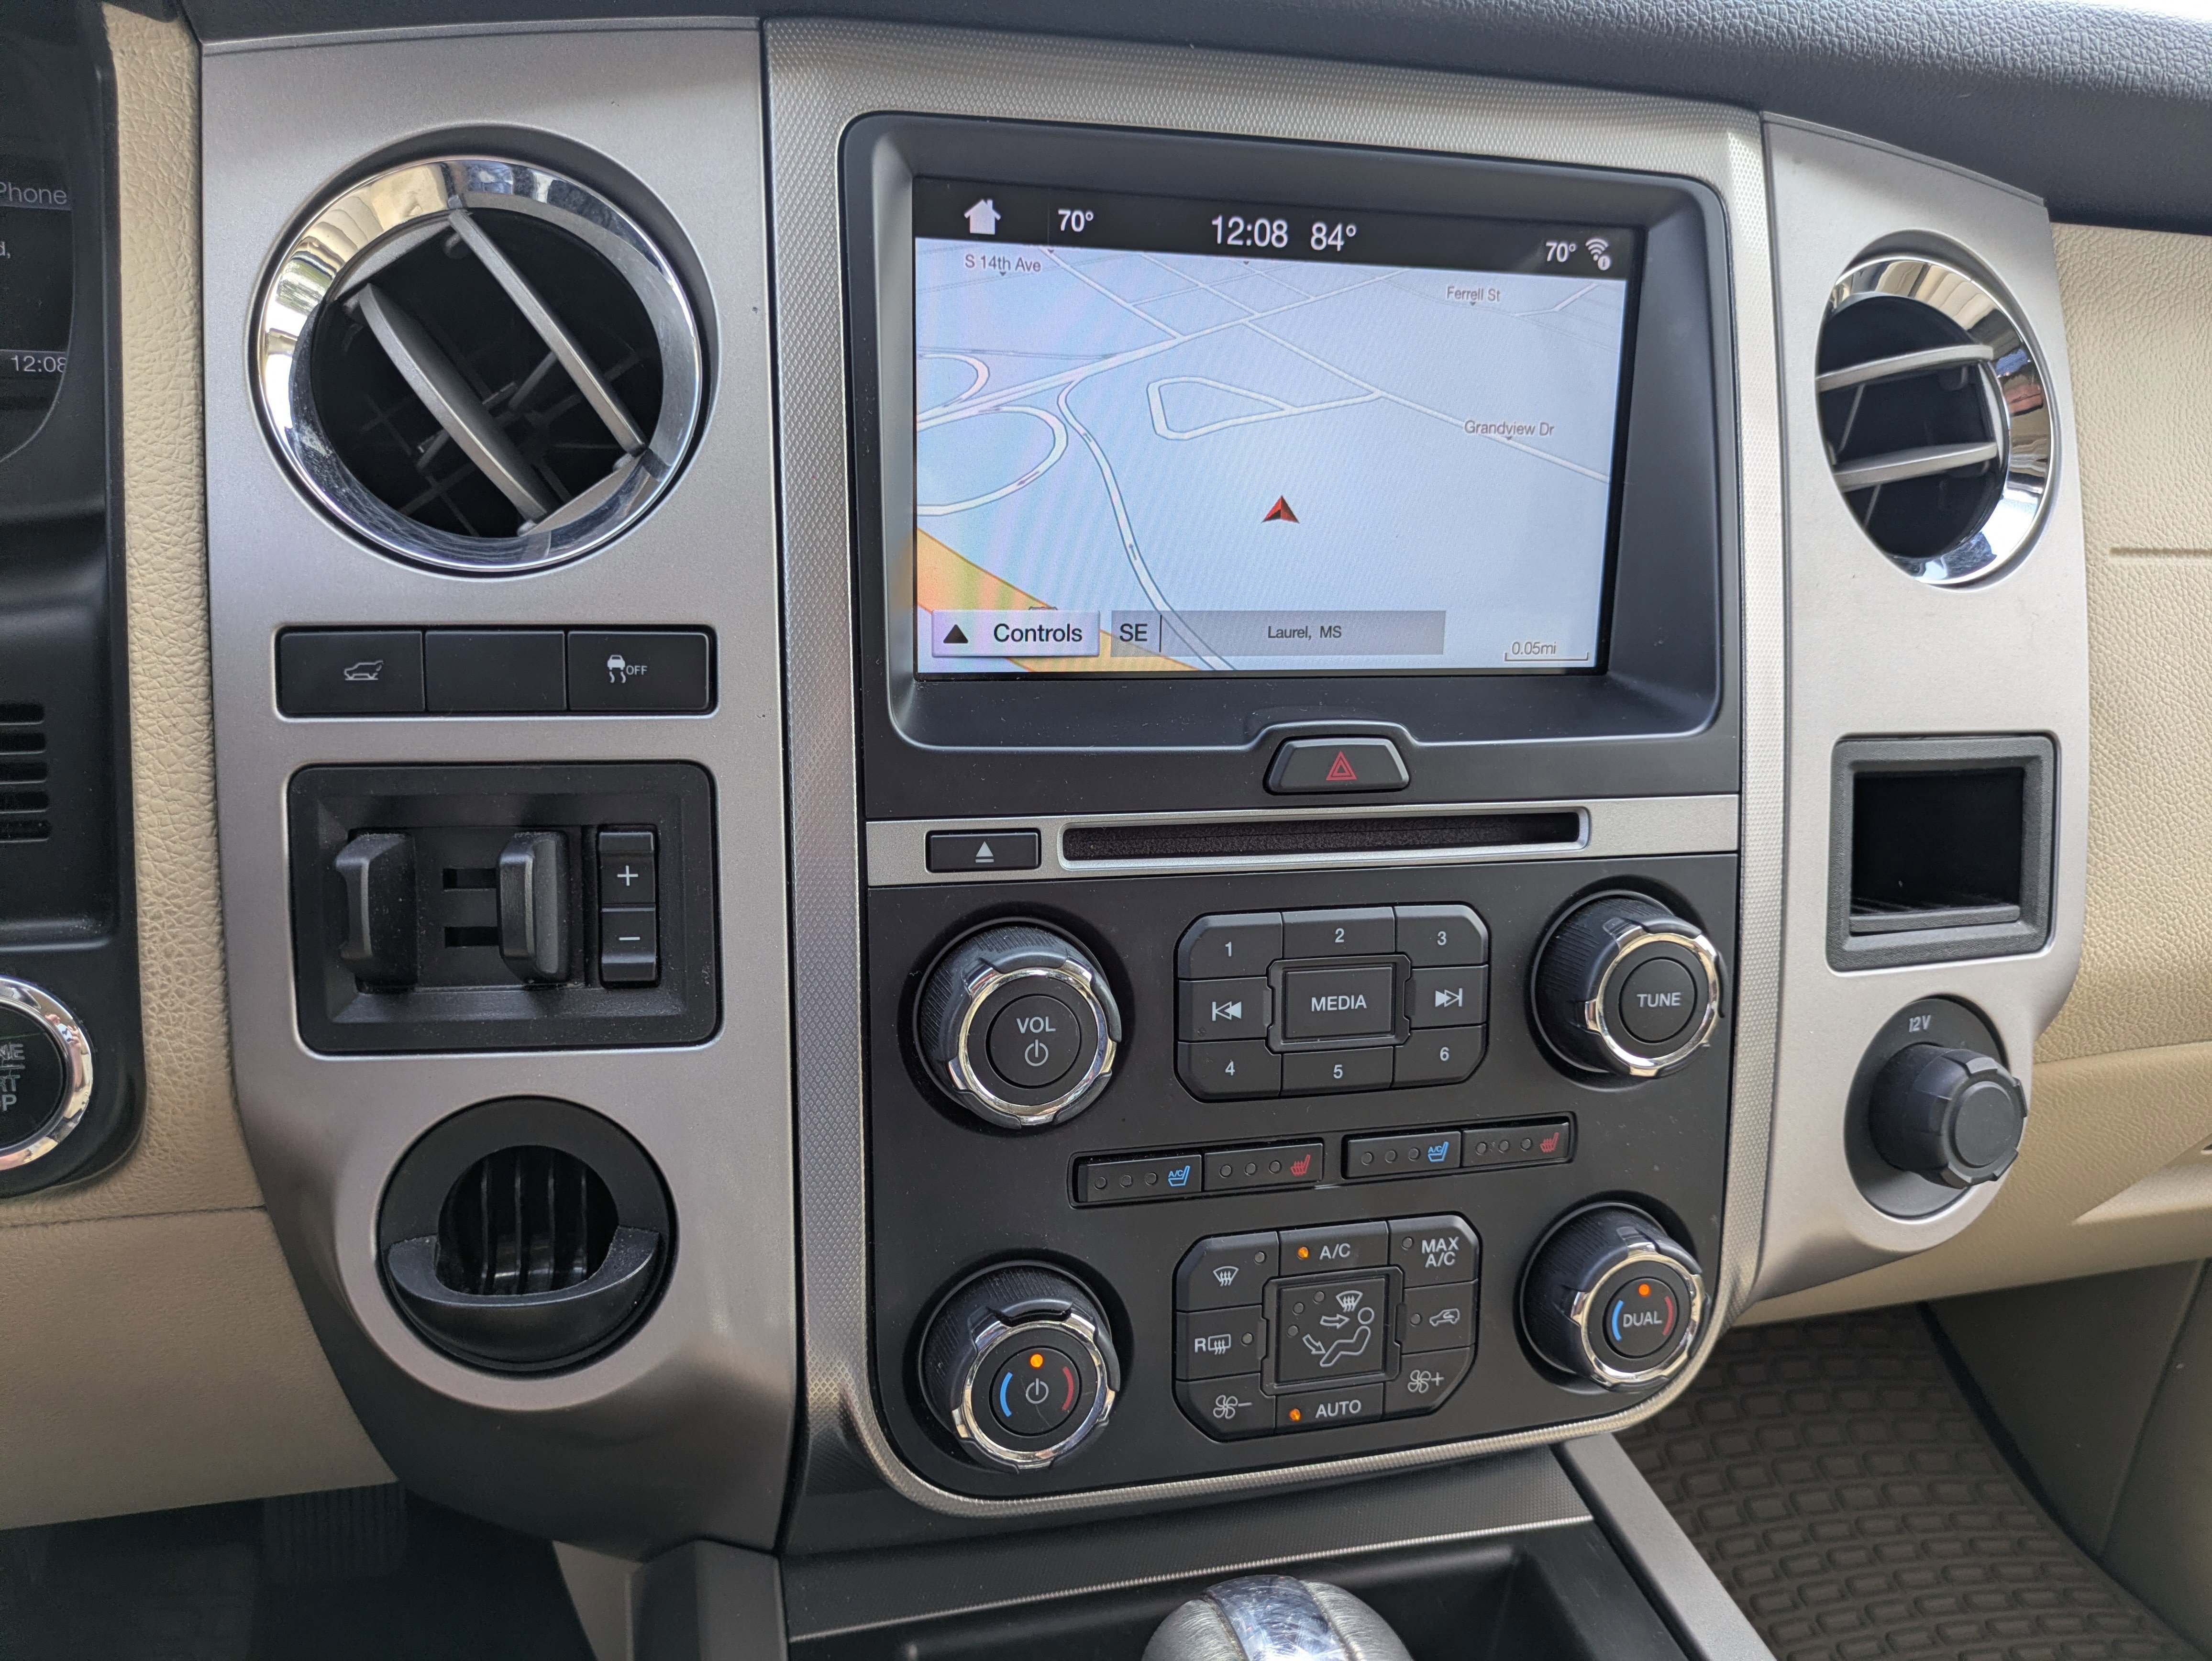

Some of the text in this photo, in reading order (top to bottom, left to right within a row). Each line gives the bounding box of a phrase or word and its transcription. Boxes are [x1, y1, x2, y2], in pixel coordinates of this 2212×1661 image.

[1211, 216, 1288, 248] 12:08
[964, 255, 1041, 272] S 14th Ave
[1447, 287, 1501, 302] Ferrell St
[11, 355, 66, 373] 12:08
[1464, 420, 1554, 436] Grandview Dr
[994, 624, 1083, 642] Controls
[1119, 624, 1148, 642] SE
[1268, 626, 1342, 641] Laurel, MS
[1511, 642, 1557, 655] 0.05mi
[626, 665, 647, 675] OFF
[1335, 928, 1345, 943] 2
[1437, 931, 1447, 946] 3
[1225, 942, 1233, 956] 1
[1311, 994, 1367, 1012] MEDIA
[1637, 992, 1682, 1008] TUNE
[1017, 1016, 1056, 1033] VOL
[1909, 1015, 1931, 1032] 12V
[1440, 1047, 1449, 1061] 6
[1225, 1061, 1235, 1076] 4
[1333, 1064, 1343, 1079] 5
[1319, 1243, 1351, 1260] A/C
[1421, 1237, 1459, 1253] MAX
[1425, 1251, 1456, 1267] A/C
[1623, 1311, 1662, 1327] DUAL
[1315, 1399, 1361, 1418] AUTO
